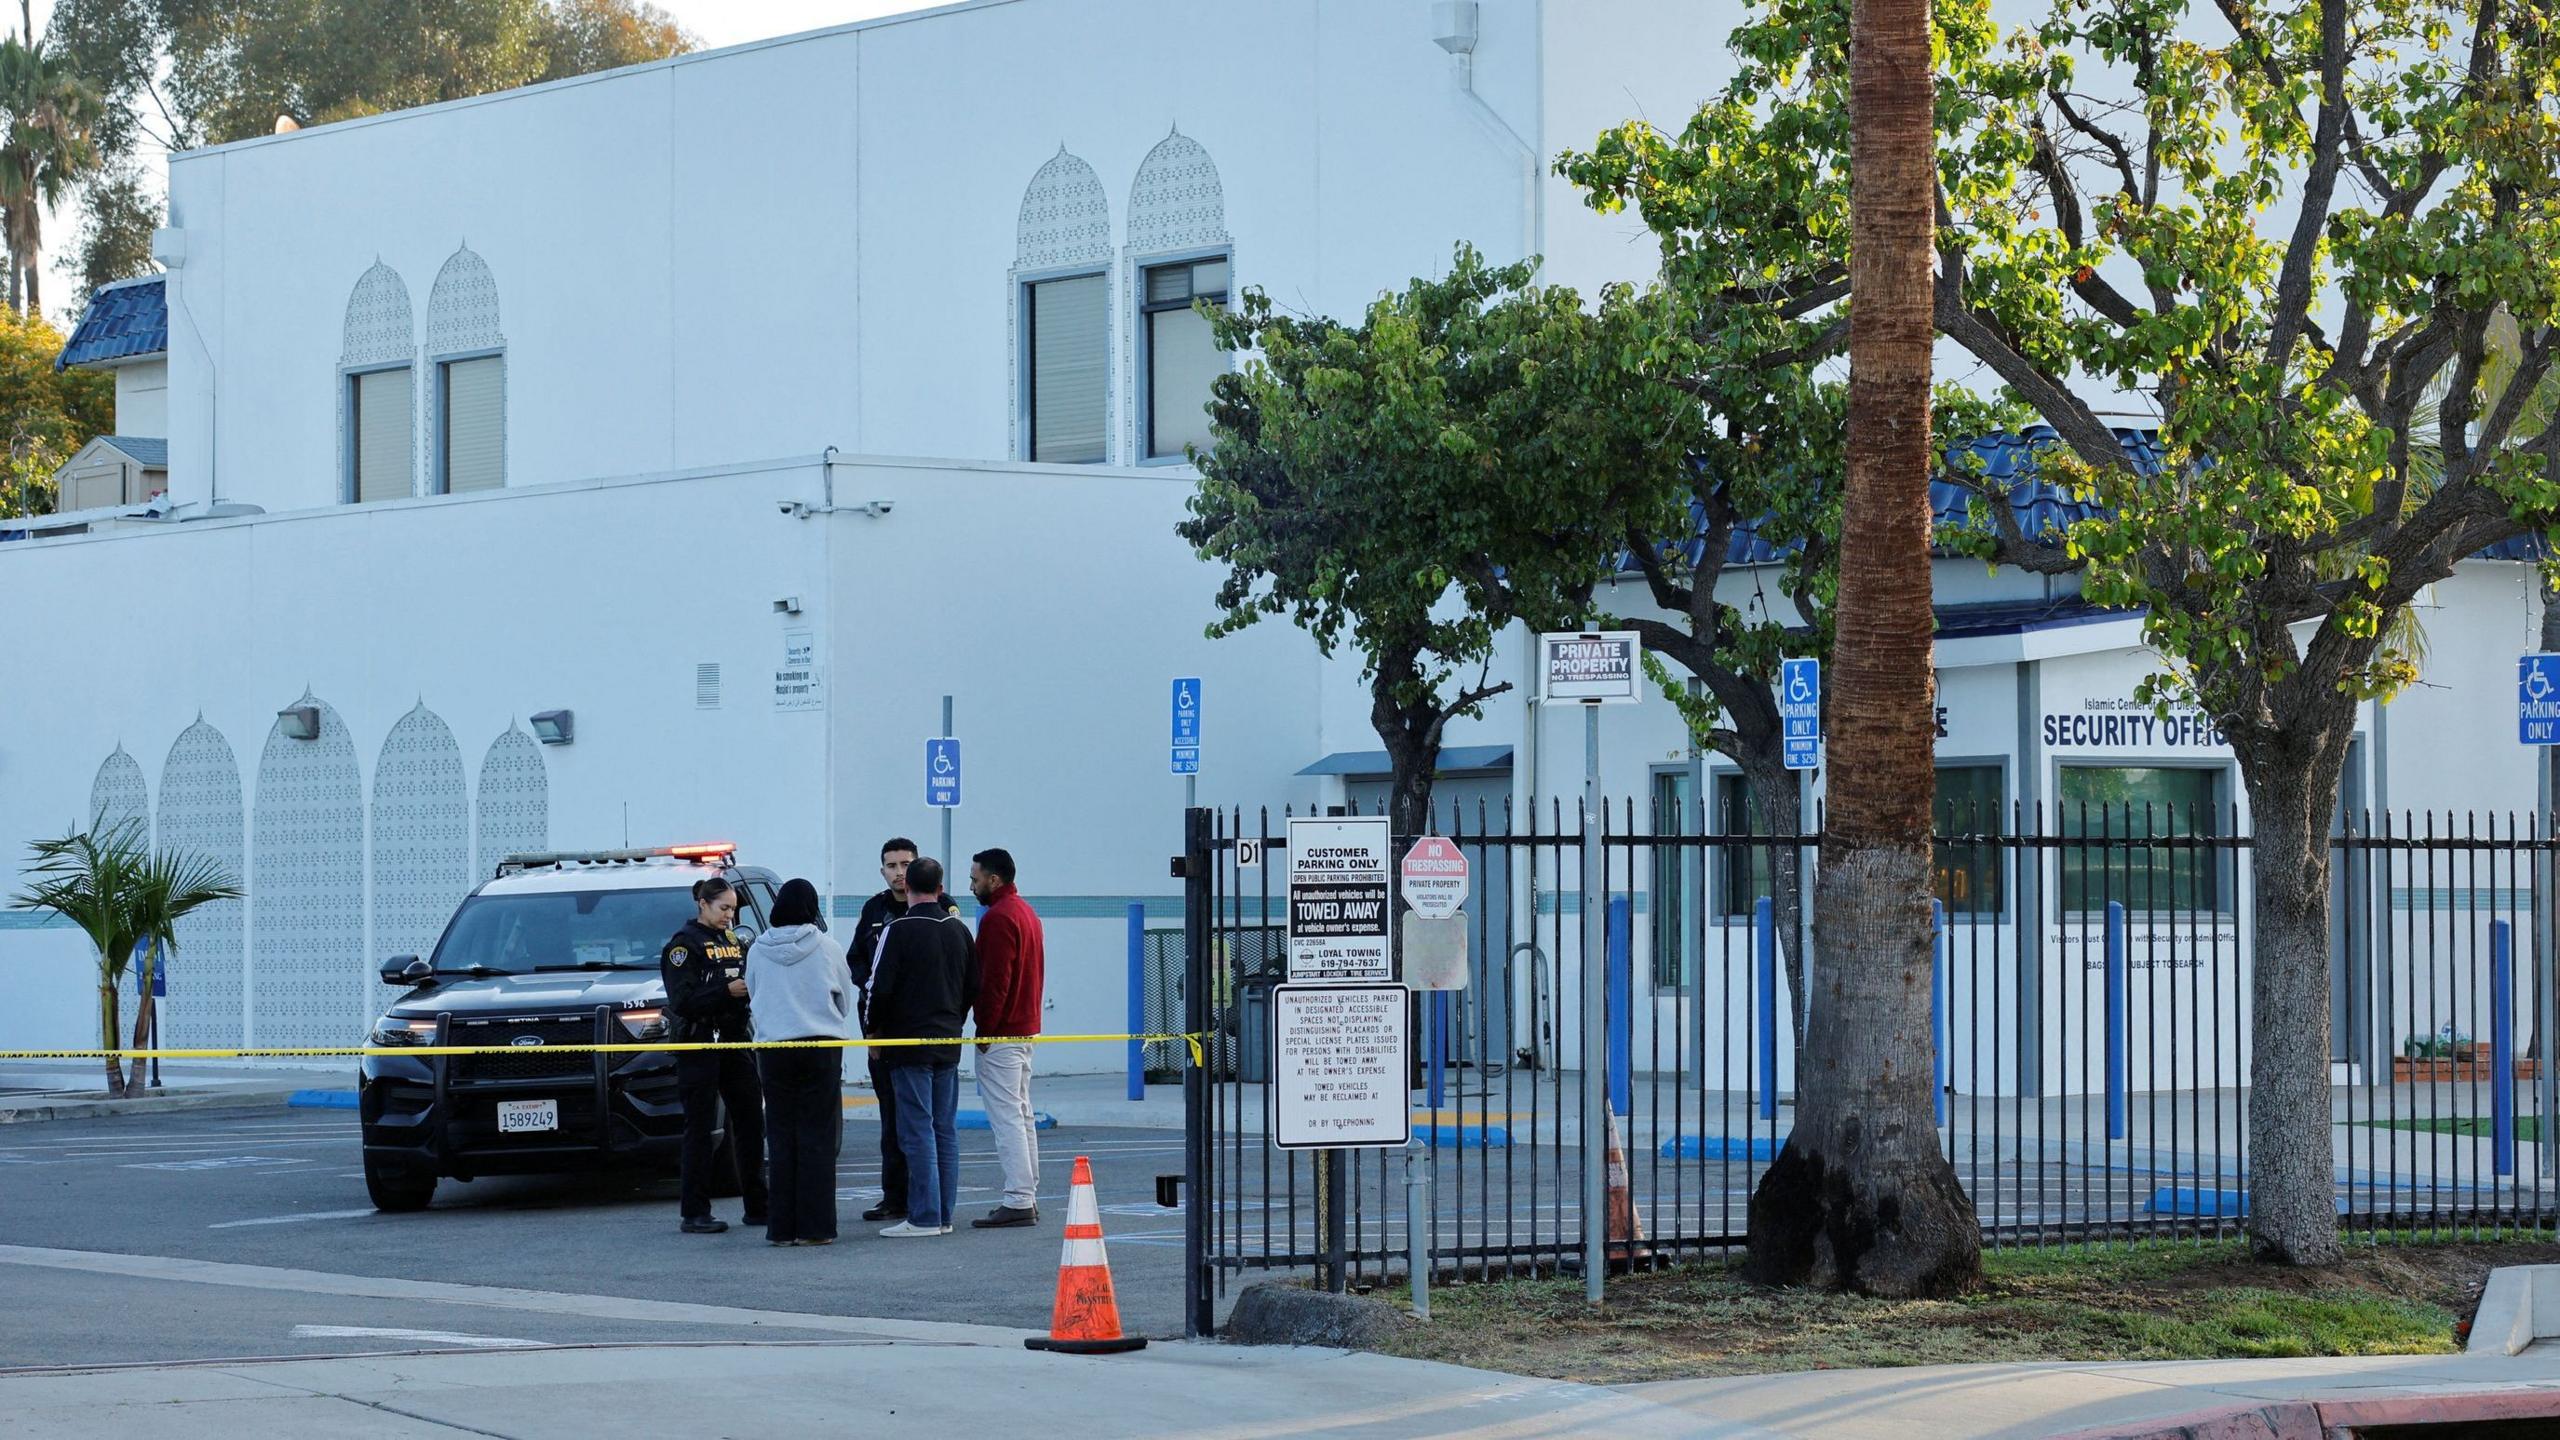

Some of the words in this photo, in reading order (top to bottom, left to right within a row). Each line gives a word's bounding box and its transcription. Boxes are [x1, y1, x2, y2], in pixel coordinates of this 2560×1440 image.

[1558, 643, 1620, 658] PRIVATE
[1551, 658, 1628, 673] PROPERTY
[2085, 698, 2115, 710] Islamic
[2148, 699, 2156, 710] of
[1786, 703, 1816, 718] PARKING
[2521, 702, 2560, 719] PARKING
[1792, 720, 1811, 735] ONLY
[2044, 714, 2156, 746] SECURITY
[2163, 715, 2229, 746] OFFIC
[2528, 722, 2553, 739] ONLY
[1791, 741, 1812, 751] MINIMUM
[1787, 755, 1798, 764] FINE
[1802, 754, 1816, 764] $250
[932, 777, 955, 787] PARKING
[937, 792, 951, 802] ONLY
[1241, 843, 1258, 863] D1
[1307, 848, 1368, 857] CUSTOMER
[1428, 844, 1442, 857] NO
[1298, 860, 1344, 869] PARKING
[1349, 859, 1379, 868] ONLY
[1407, 859, 1463, 872] TRESPASSING
[1308, 874, 1325, 882] PUBLIC
[1327, 874, 1349, 882] PARKING
[1409, 880, 1430, 888] PRIVATE
[1433, 880, 1460, 888] PROPERTY
[1293, 890, 1301, 900] All
[1302, 890, 1337, 900] unauthorized
[1338, 890, 1363, 899] vehicles
[1365, 889, 1375, 899] will
[1377, 889, 1385, 899] be
[1297, 903, 1339, 920] TOWED
[1344, 902, 1380, 919] AWAY
[1297, 925, 1303, 933] at
[1305, 923, 1324, 932] vehicle
[1326, 923, 1350, 932] owner's
[1352, 924, 1380, 933] expense.
[2051, 935, 2079, 943] Vistors
[2153, 934, 2181, 944] Secuty
[2195, 934, 2213, 943] Admi
[2218, 934, 2236, 942] Offic
[706, 946, 742, 959] POLICE
[1321, 959, 1379, 967] 619-794-7637
[2132, 960, 2160, 968] UBJET
[1285, 996, 1332, 1004] UNAUTHORIZED
[1337, 995, 1368, 1003] VEHICLES
[1294, 1006, 1301, 1014] IN
[1305, 1006, 1343, 1014] DESIGNATED
[1349, 1005, 1388, 1013] ACCESSIBLE
[1328, 1016, 1340, 1024] NOT
[1346, 1026, 1379, 1034] PLACARDS
[1316, 1037, 1342, 1045] LICENSE
[1302, 1047, 1331, 1055] PERSONS
[1355, 1046, 1397, 1054] DISABILITIES
[1336, 1057, 1357, 1065] TOWED
[1315, 1083, 1334, 1091] TOWED
[1304, 1094, 1316, 1102] MAY
[1332, 1093, 1367, 1101] RECLAIMED
[502, 1111, 553, 1128] 1589249
[1333, 1119, 1375, 1127] TELEPHONING
